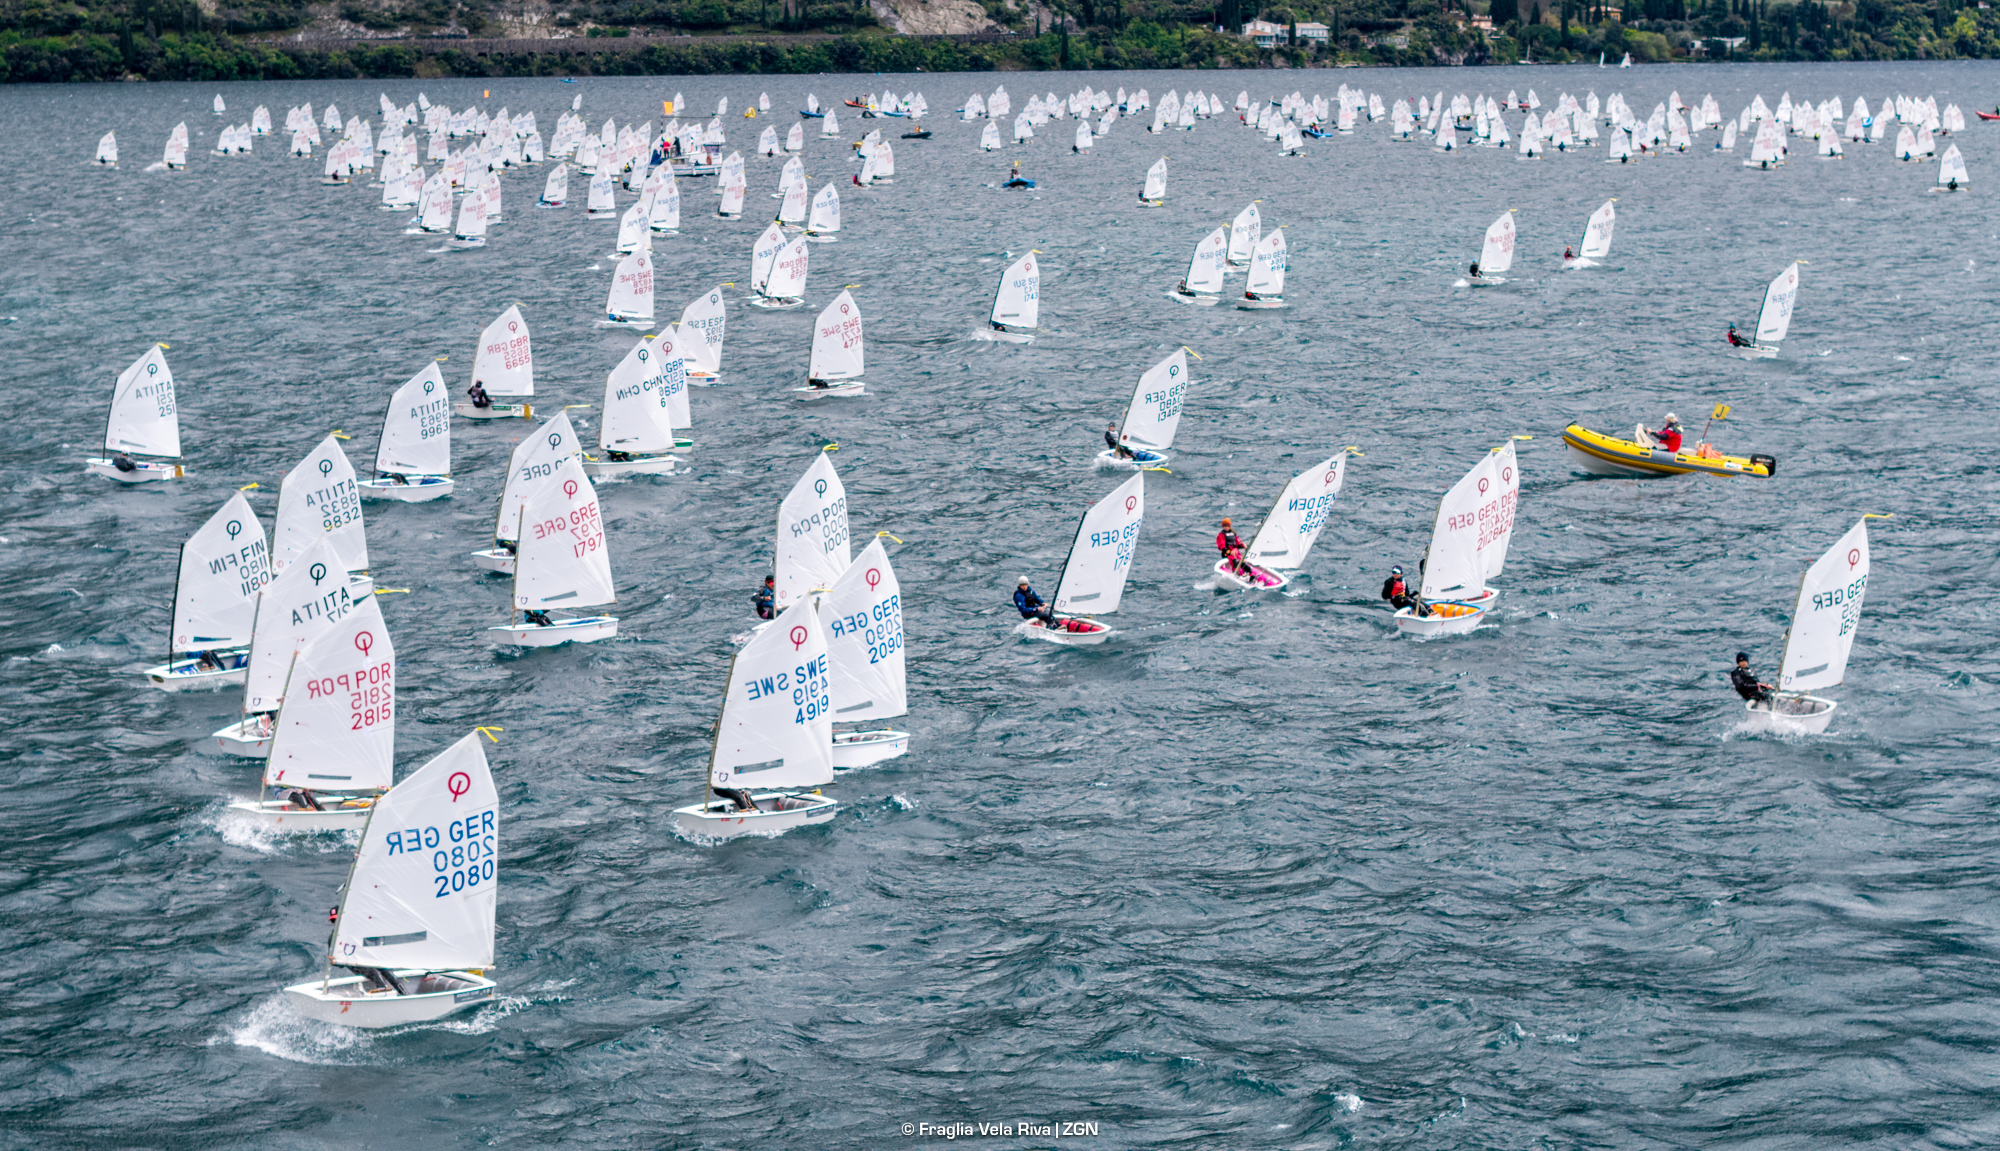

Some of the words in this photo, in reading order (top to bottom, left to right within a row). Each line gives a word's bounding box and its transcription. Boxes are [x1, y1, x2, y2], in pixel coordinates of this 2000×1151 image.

[774, 242, 786, 252] GER
[638, 270, 652, 280] SWE
[708, 316, 724, 327] ESP
[842, 316, 860, 331] SWE
[510, 335, 529, 348] GBR
[665, 358, 684, 373] GBR
[155, 381, 172, 394] ITA
[643, 375, 663, 391] CHN
[665, 380, 684, 397] 6517
[1170, 382, 1186, 397] GER
[159, 403, 176, 417] 251
[431, 397, 448, 413] ITA
[421, 421, 449, 440] 9963
[333, 478, 356, 498] ITA
[1501, 488, 1518, 508] DEN
[323, 506, 361, 532] 9832
[570, 501, 598, 525] GRE
[822, 497, 845, 522] POR
[1478, 500, 1496, 521] GER
[240, 539, 265, 562] FIN
[574, 532, 603, 558] 1797
[824, 527, 848, 554] 1000
[241, 571, 269, 596] 1180
[1847, 574, 1867, 599] GER
[323, 586, 350, 611] ITA
[873, 595, 900, 622] GER
[868, 632, 903, 665] 2090
[355, 662, 391, 689] POR
[795, 653, 828, 684] SWE
[351, 702, 391, 730] 2815
[795, 695, 829, 725] 4919
[449, 810, 494, 843] GER
[434, 859, 494, 898] 2080
